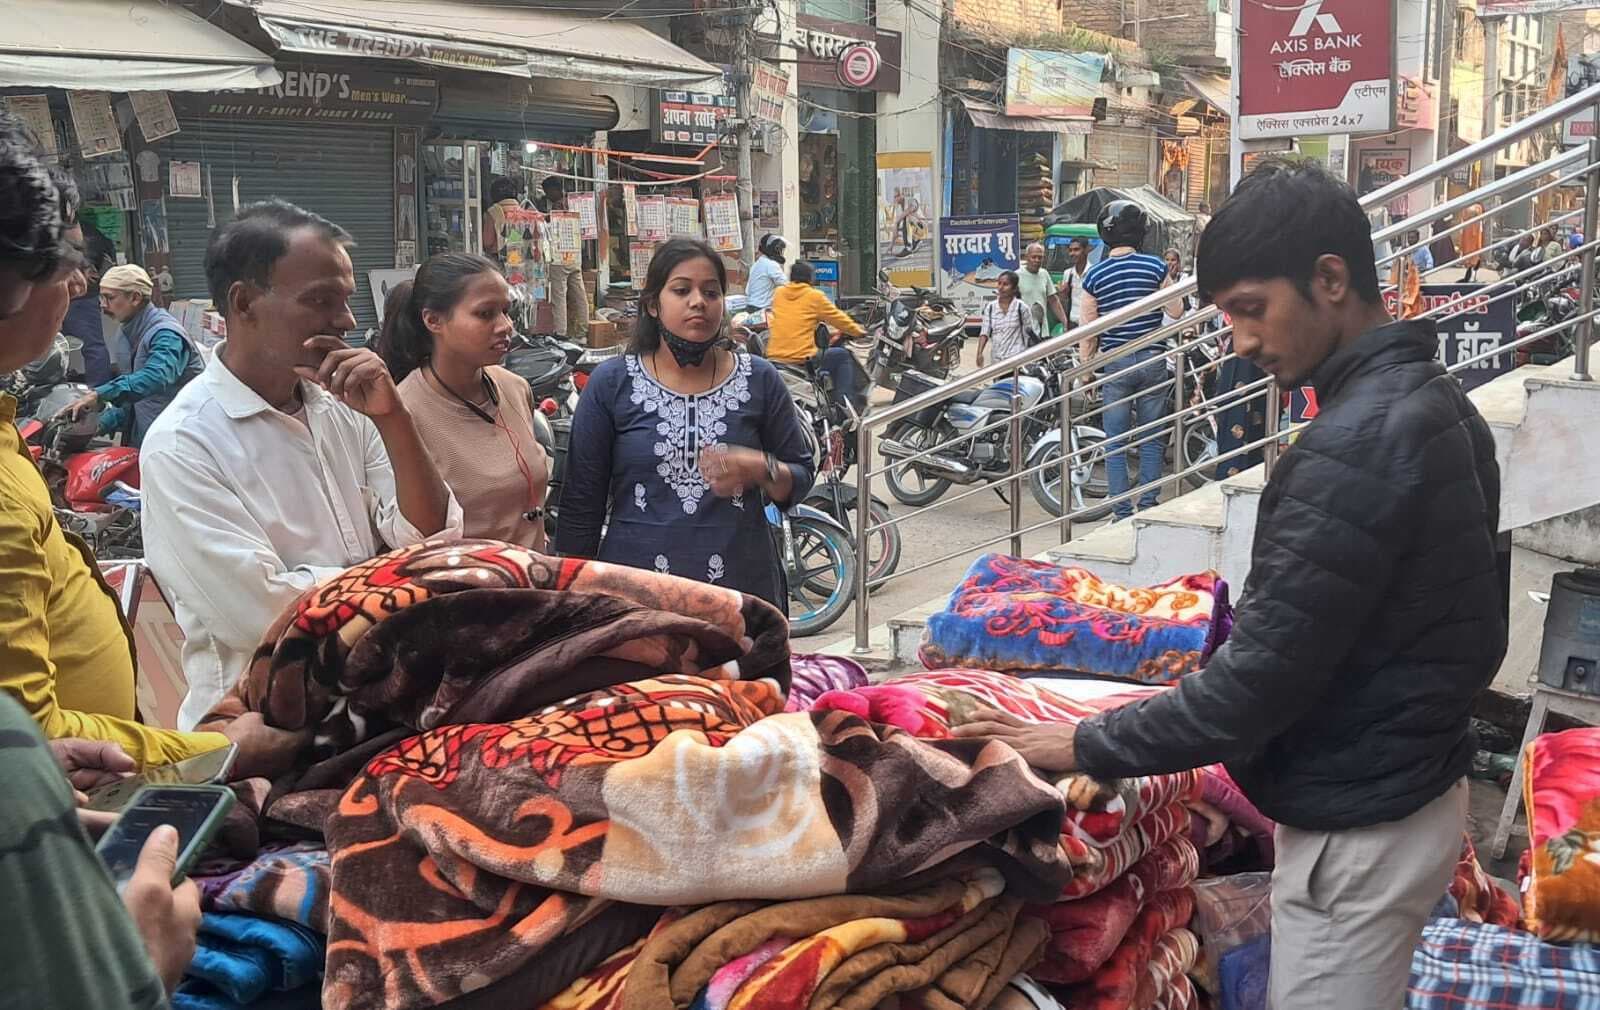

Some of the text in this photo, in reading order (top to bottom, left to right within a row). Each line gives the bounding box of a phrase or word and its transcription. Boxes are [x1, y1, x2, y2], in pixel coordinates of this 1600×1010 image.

[296, 27, 338, 50] THE
[1269, 33, 1363, 55] AXIS BANK
[1329, 55, 1352, 73] बैंक
[1354, 84, 1388, 99] एटीएम
[1332, 113, 1364, 127] 24x7
[943, 231, 1017, 261] सरदार शू
